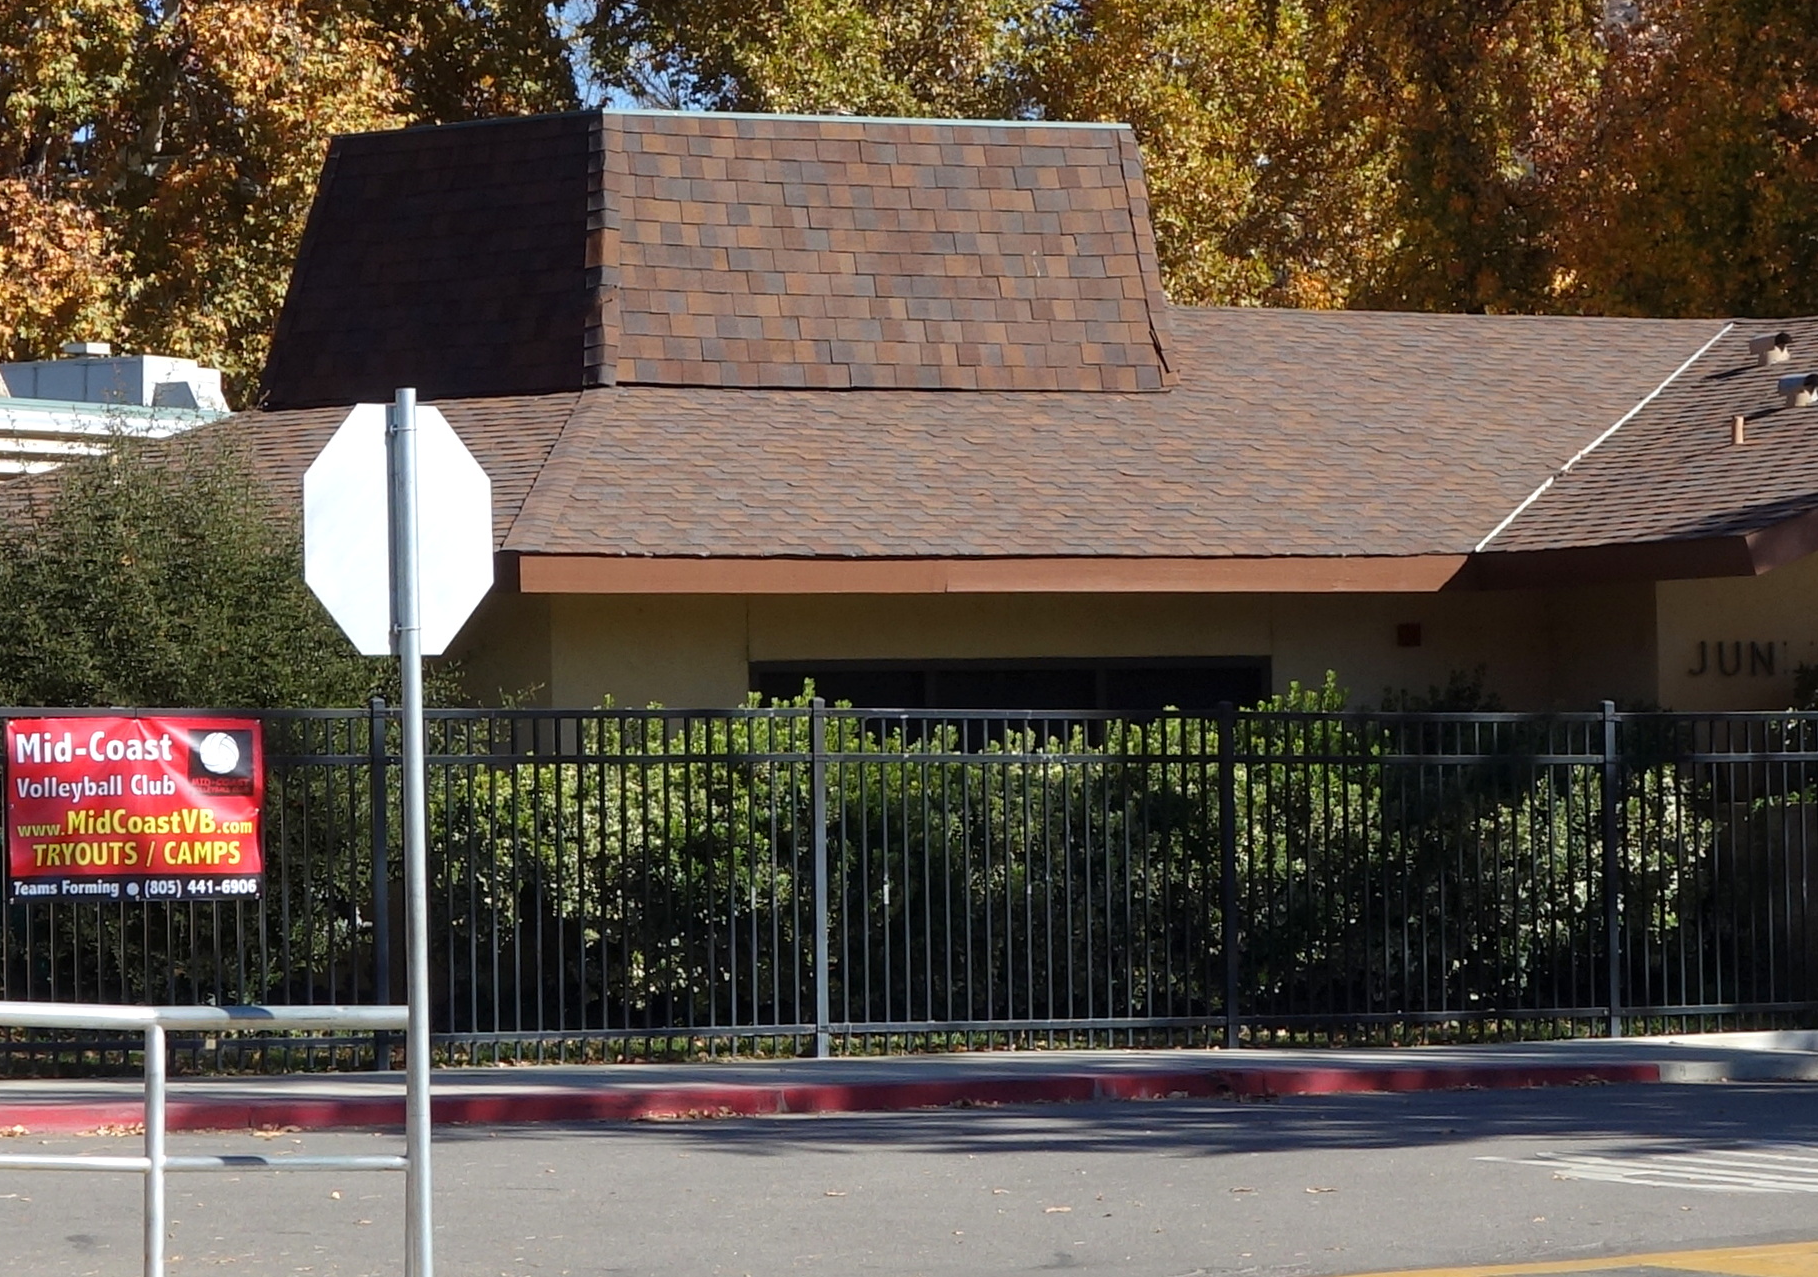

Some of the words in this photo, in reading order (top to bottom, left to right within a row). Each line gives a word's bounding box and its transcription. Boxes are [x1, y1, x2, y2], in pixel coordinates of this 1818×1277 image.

[16, 731, 173, 764] Mid-Coast
[16, 776, 123, 803] Volleyball
[131, 774, 176, 796] Club
[17, 808, 252, 837] www.MidCoastVB.com
[32, 841, 138, 867] TRYOUTS
[146, 841, 156, 867] /
[164, 840, 241, 866] CAMPS
[13, 881, 58, 896] Teams
[62, 879, 120, 898] Forming
[144, 879, 182, 898] (805)
[187, 879, 257, 894] 441-6906
